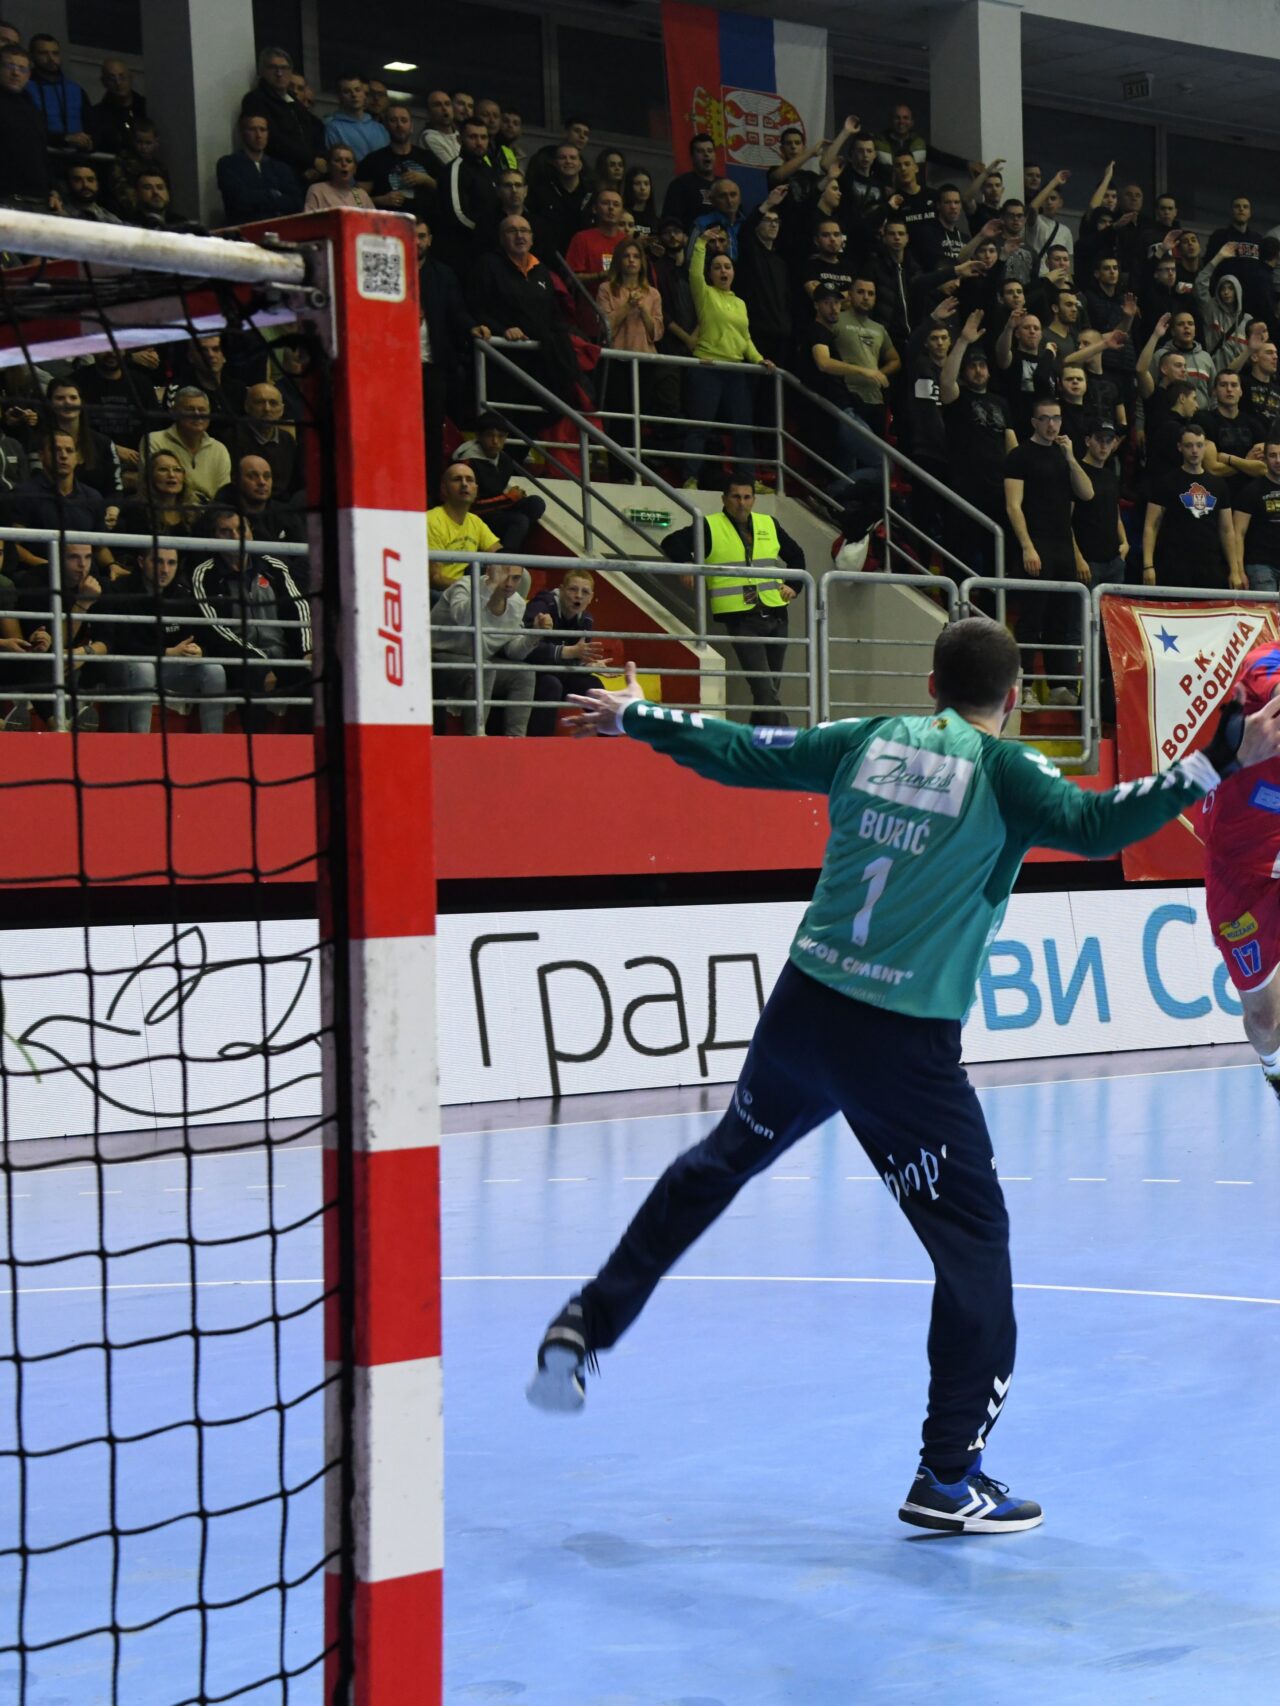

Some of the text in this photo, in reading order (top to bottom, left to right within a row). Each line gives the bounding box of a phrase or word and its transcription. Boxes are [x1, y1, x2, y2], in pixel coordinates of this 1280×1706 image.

[378, 547, 404, 687] elan
[1161, 620, 1255, 761] ВОЈВОДИНА
[1179, 648, 1216, 697] Р.К.
[858, 808, 930, 855] BURIĆ
[851, 856, 894, 947] 1
[1231, 940, 1262, 978] 17
[470, 932, 767, 1098] Град
[961, 936, 1111, 1031] ви
